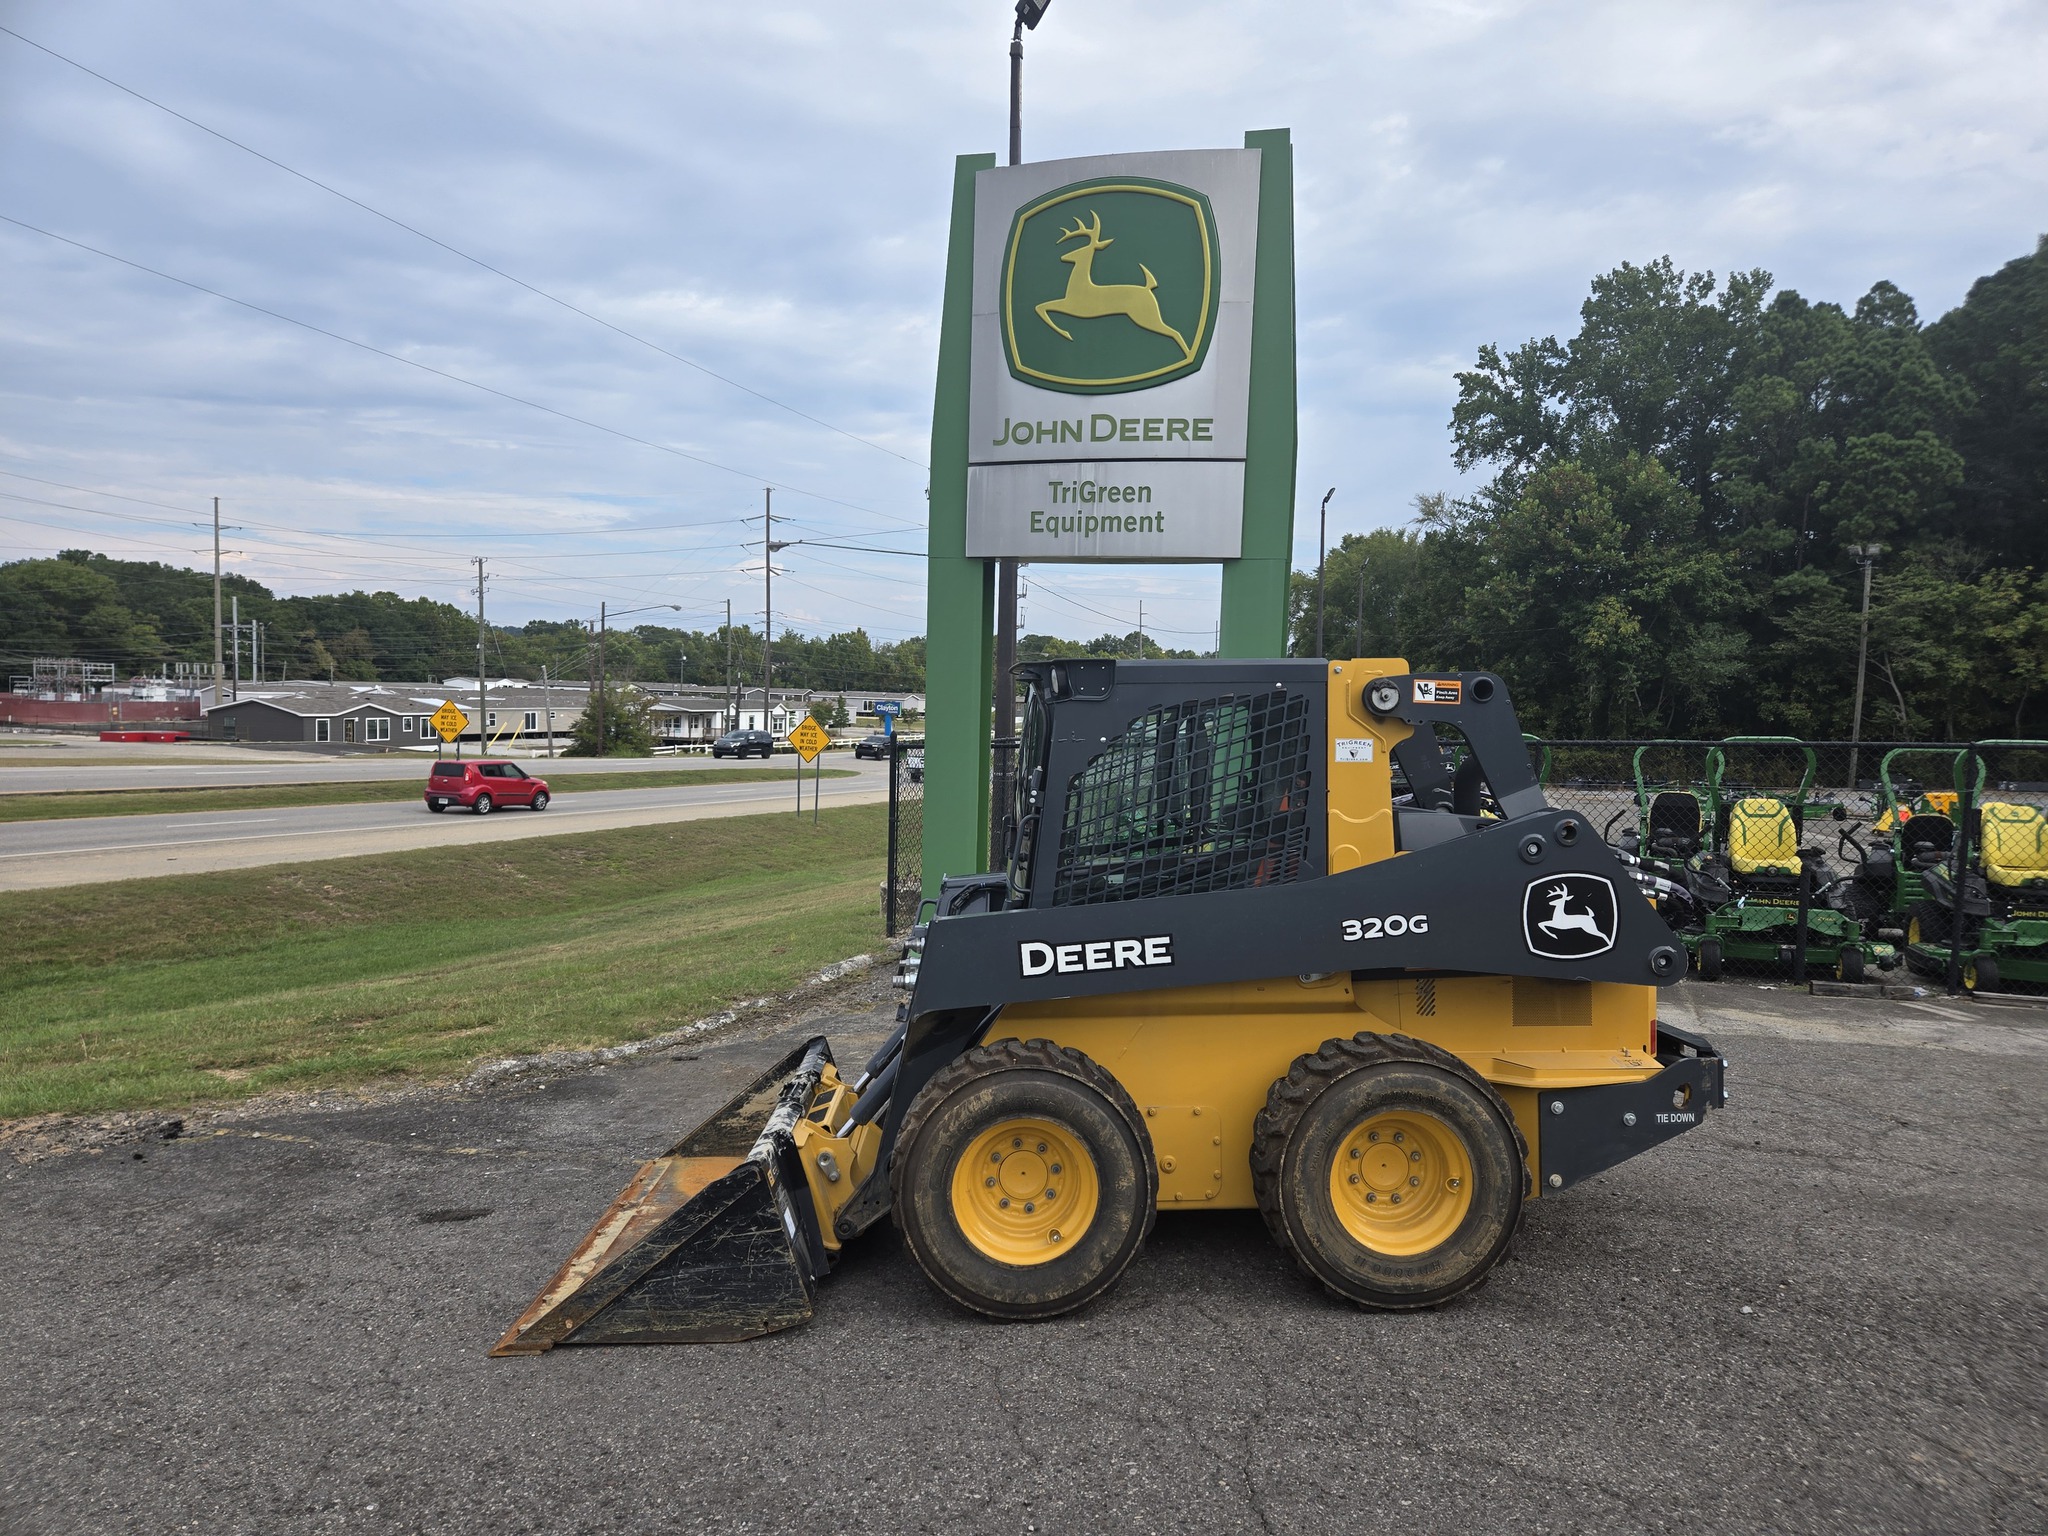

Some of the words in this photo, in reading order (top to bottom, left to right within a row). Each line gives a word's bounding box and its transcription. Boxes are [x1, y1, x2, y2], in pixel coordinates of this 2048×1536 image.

[993, 417, 1083, 446] JOHN
[1090, 413, 1214, 443] DEERE
[1048, 480, 1152, 503] TriGreen
[1030, 510, 1164, 538] Equipment
[876, 704, 899, 712] Clayton
[1342, 914, 1429, 941] 320G
[1020, 936, 1172, 976] DEERE
[1656, 1113, 1669, 1123] TIE
[1670, 1113, 1695, 1123] DOWN
